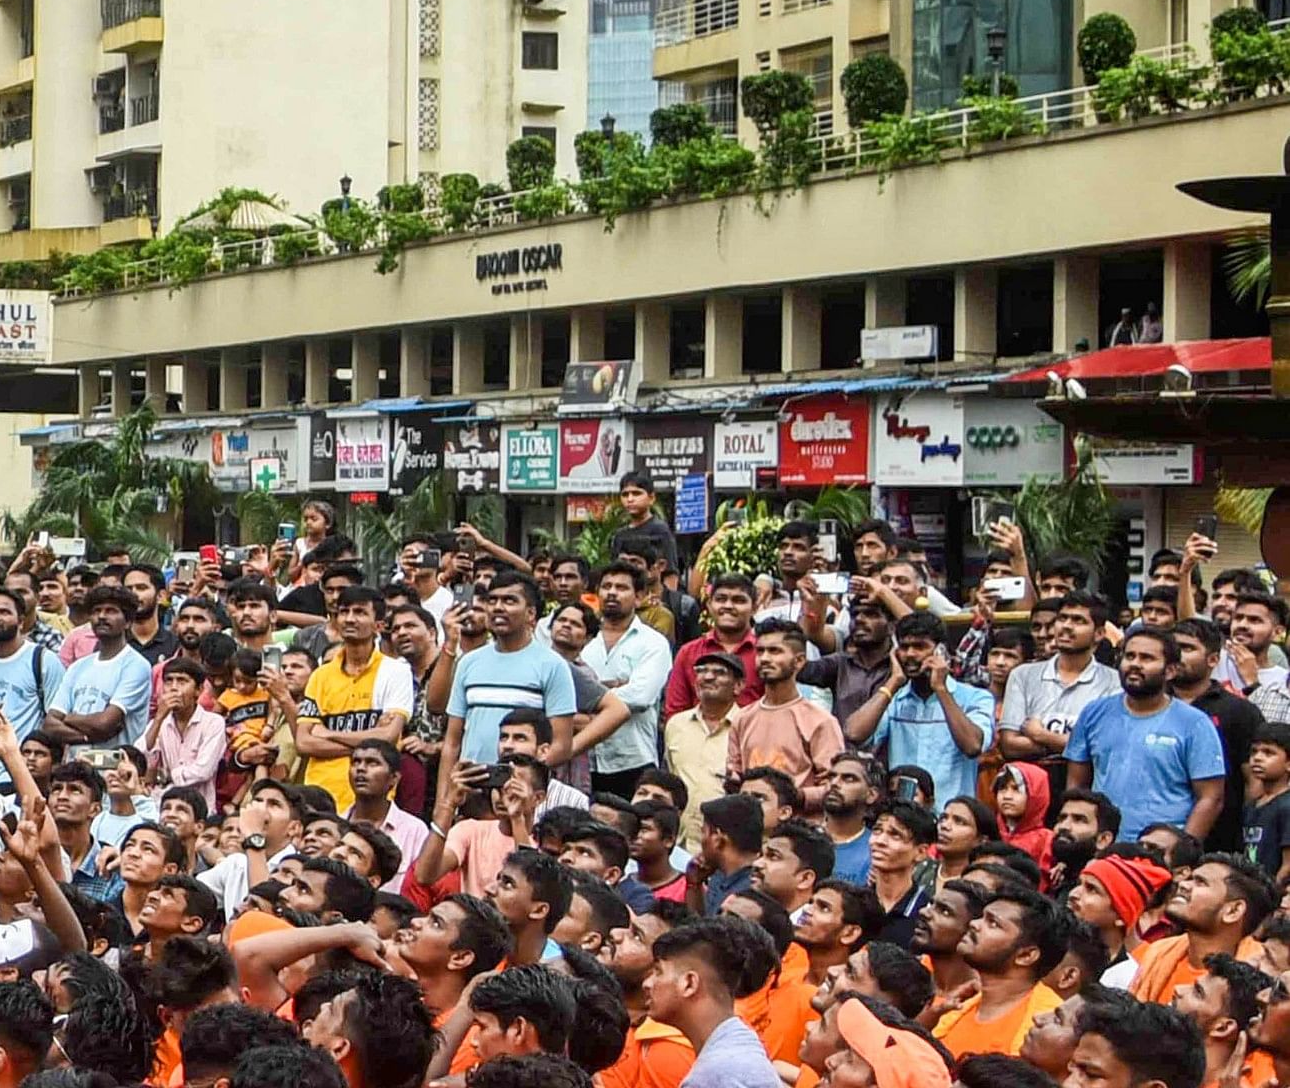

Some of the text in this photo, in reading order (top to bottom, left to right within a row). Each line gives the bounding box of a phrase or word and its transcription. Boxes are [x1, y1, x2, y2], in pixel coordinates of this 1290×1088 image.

[522, 243, 563, 273] OSCAR
[406, 427, 422, 444] The
[724, 434, 765, 454] ROYAL
[509, 436, 553, 456] ELLORA
[405, 449, 437, 469] Service
